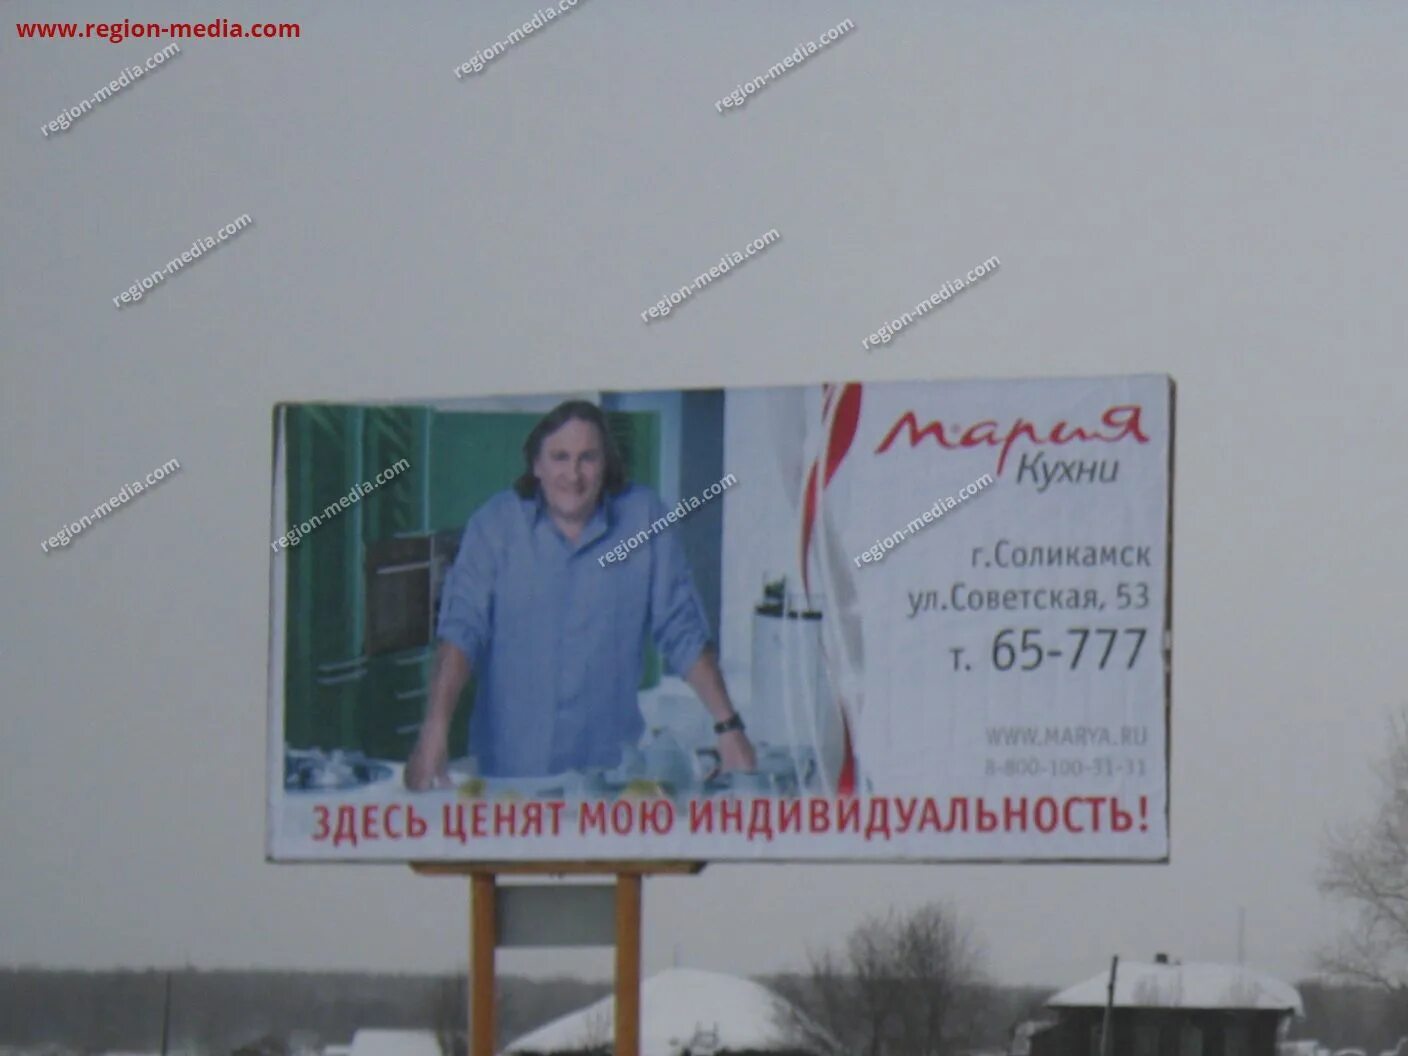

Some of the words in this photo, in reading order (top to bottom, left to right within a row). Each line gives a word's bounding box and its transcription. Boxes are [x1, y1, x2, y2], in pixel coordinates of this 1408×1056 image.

[1016, 451, 1120, 491] Кухни
[971, 539, 1152, 569] г.Соликамск
[907, 583, 1106, 616] ул.Советская,
[1116, 584, 1151, 611] 53
[991, 628, 1149, 672] 65-777
[986, 726, 1148, 749] WWW.MARYA.RU
[312, 803, 428, 847] ЗДЕСЬ
[442, 801, 565, 844] ЦЕНЯТ
[579, 799, 675, 837] МОЮ
[689, 796, 1150, 842] ИНДИВИДУАЛЬНОСТЬ!
